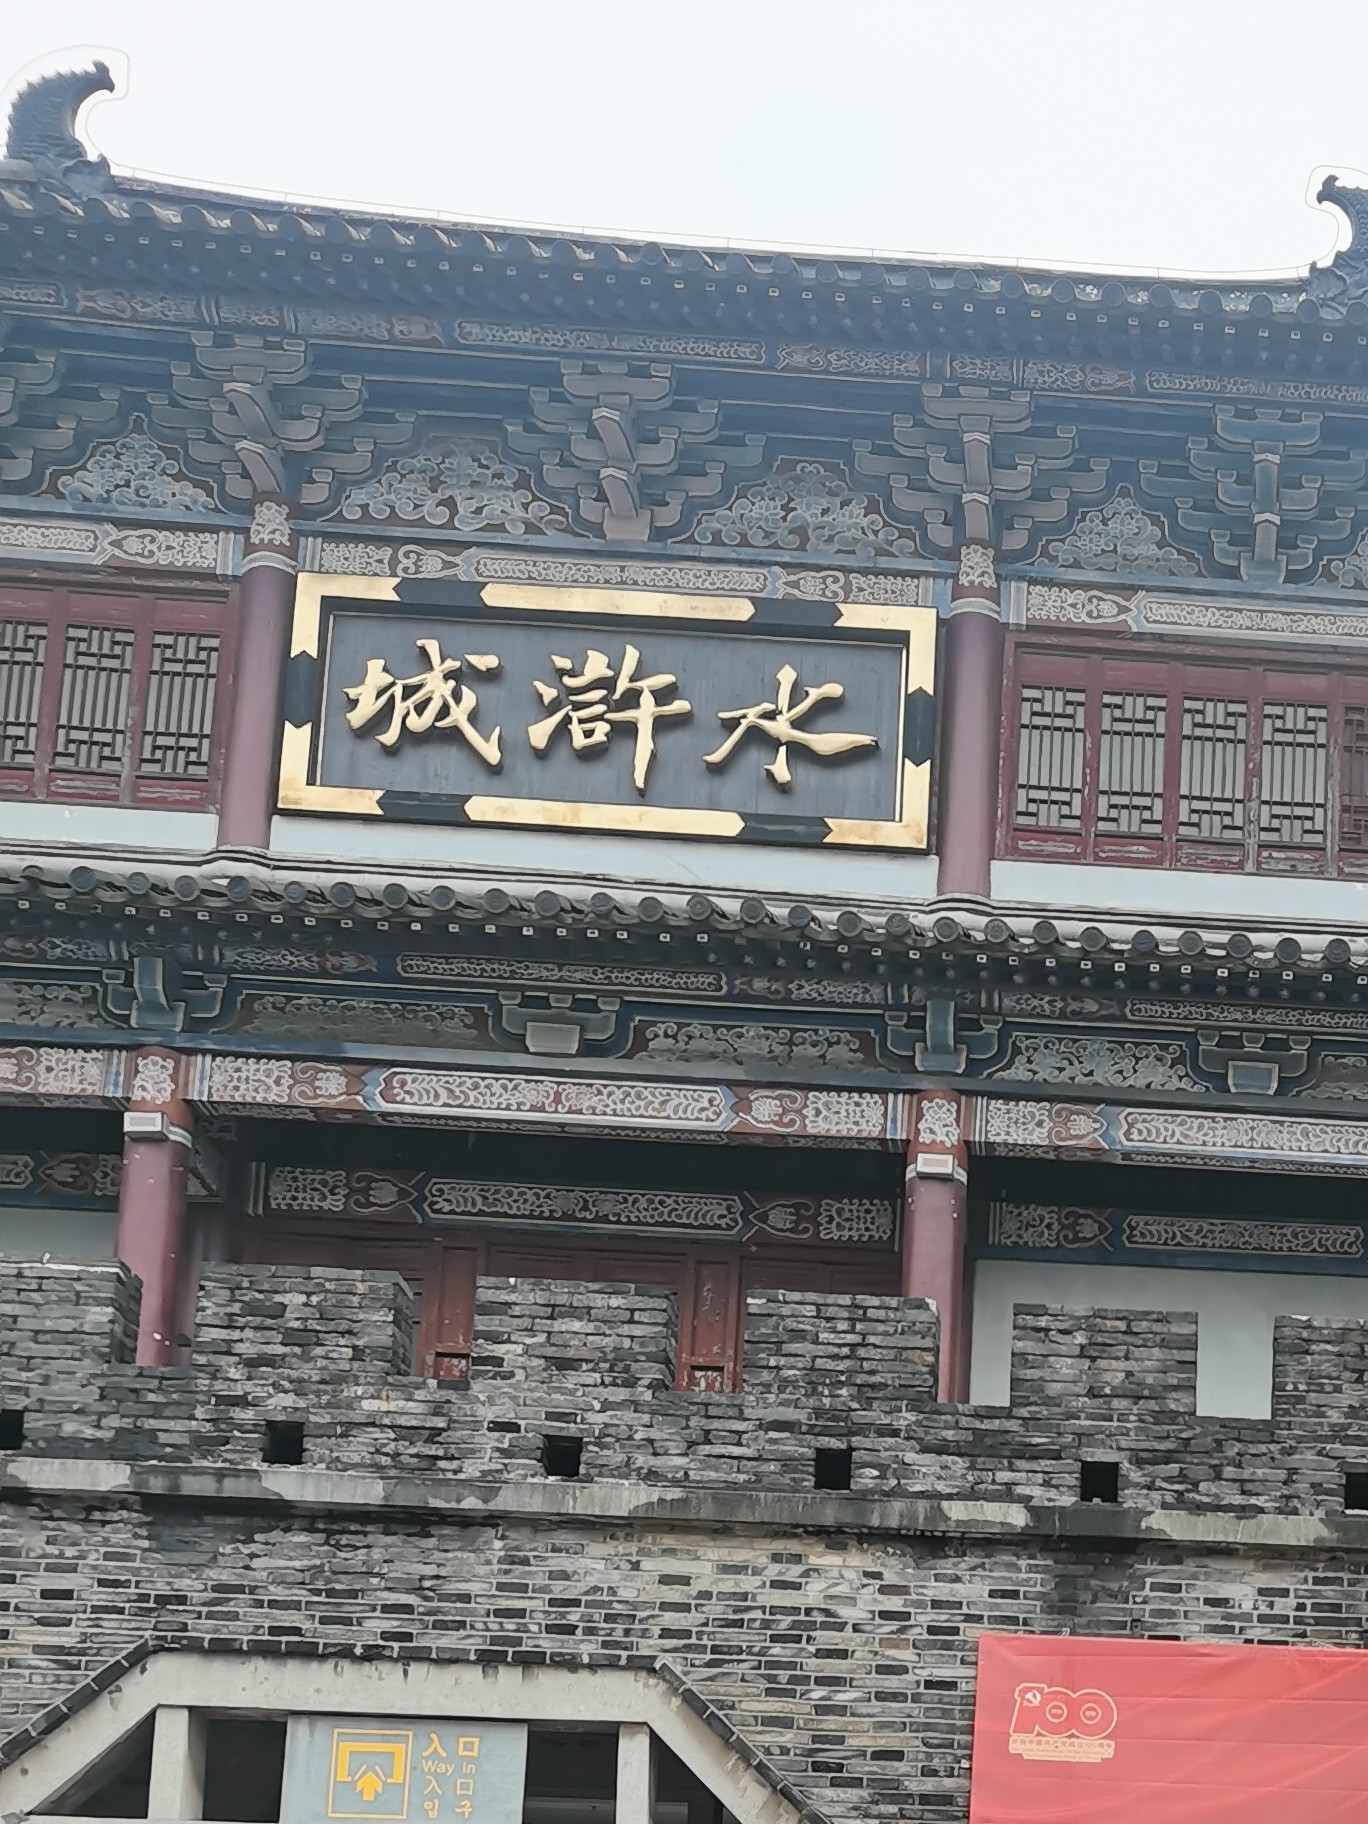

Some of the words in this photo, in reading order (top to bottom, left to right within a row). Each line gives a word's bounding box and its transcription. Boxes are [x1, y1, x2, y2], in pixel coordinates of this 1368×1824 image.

[421, 1732, 480, 1757] 入口
[422, 1760, 455, 1777] Way
[462, 1761, 476, 1774] in
[423, 1776, 474, 1796] 入口
[422, 1799, 473, 1820] 입구
